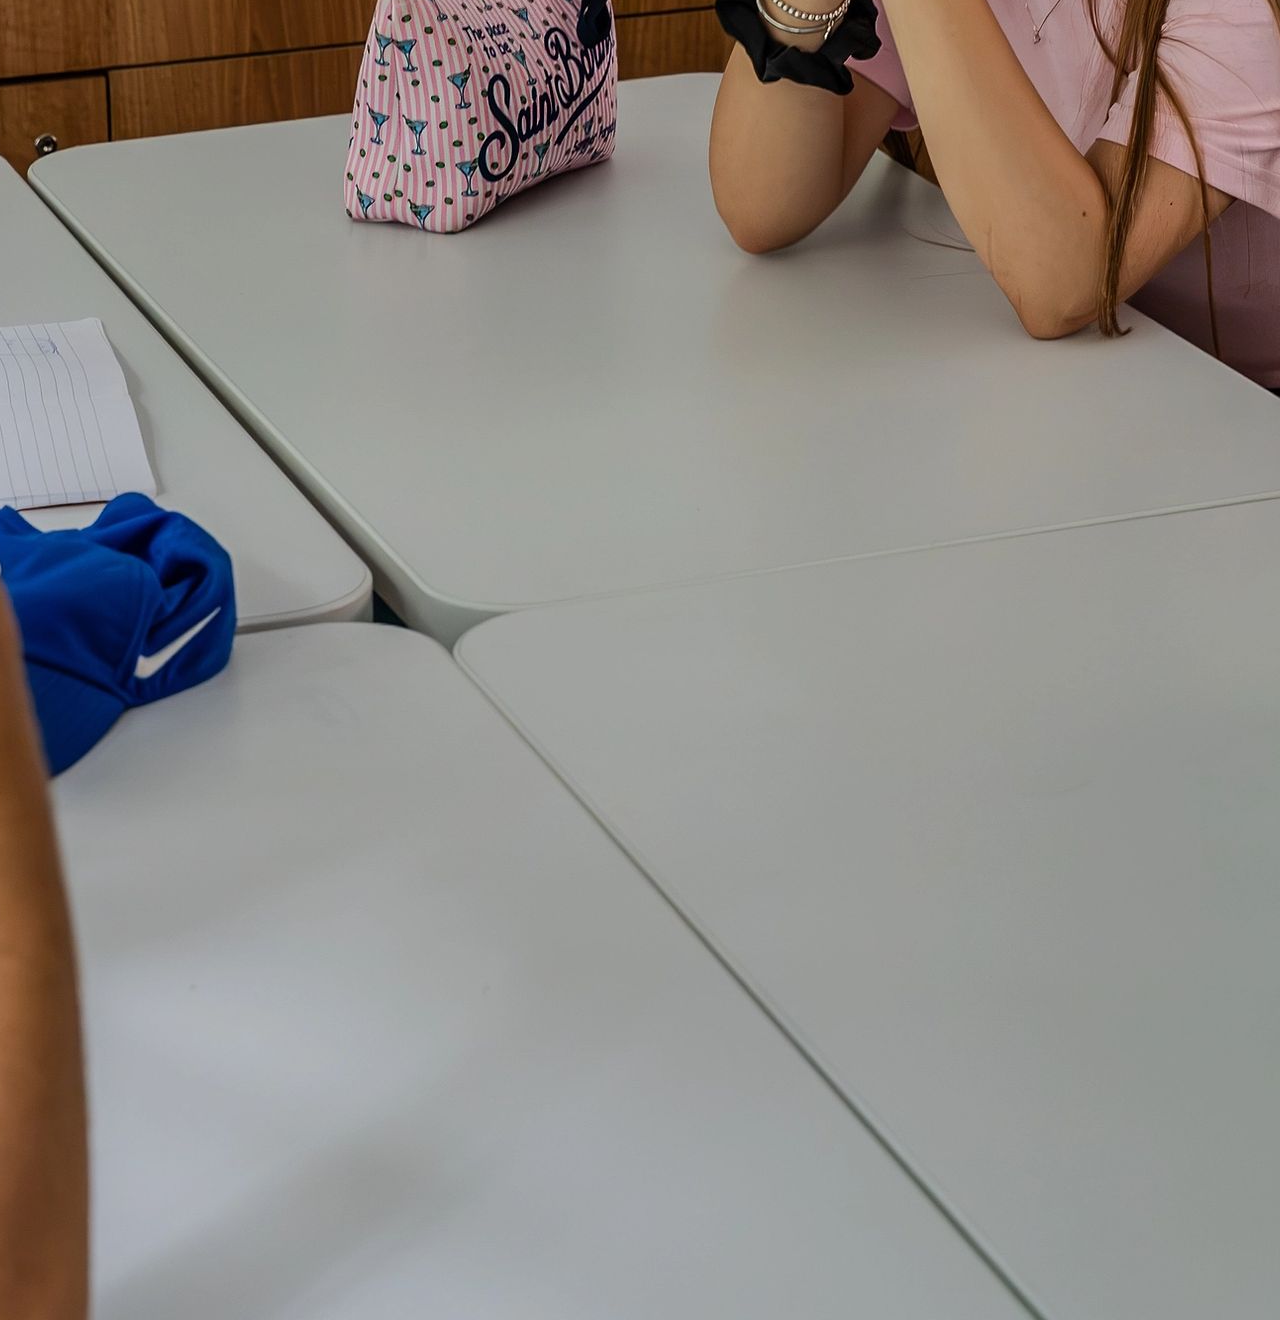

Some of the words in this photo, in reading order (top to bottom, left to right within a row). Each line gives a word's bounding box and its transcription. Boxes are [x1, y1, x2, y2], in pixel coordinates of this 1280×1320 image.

[463, 24, 486, 44] The
[483, 44, 497, 61] to
[495, 39, 512, 55] be
[477, 68, 560, 181] Saint
